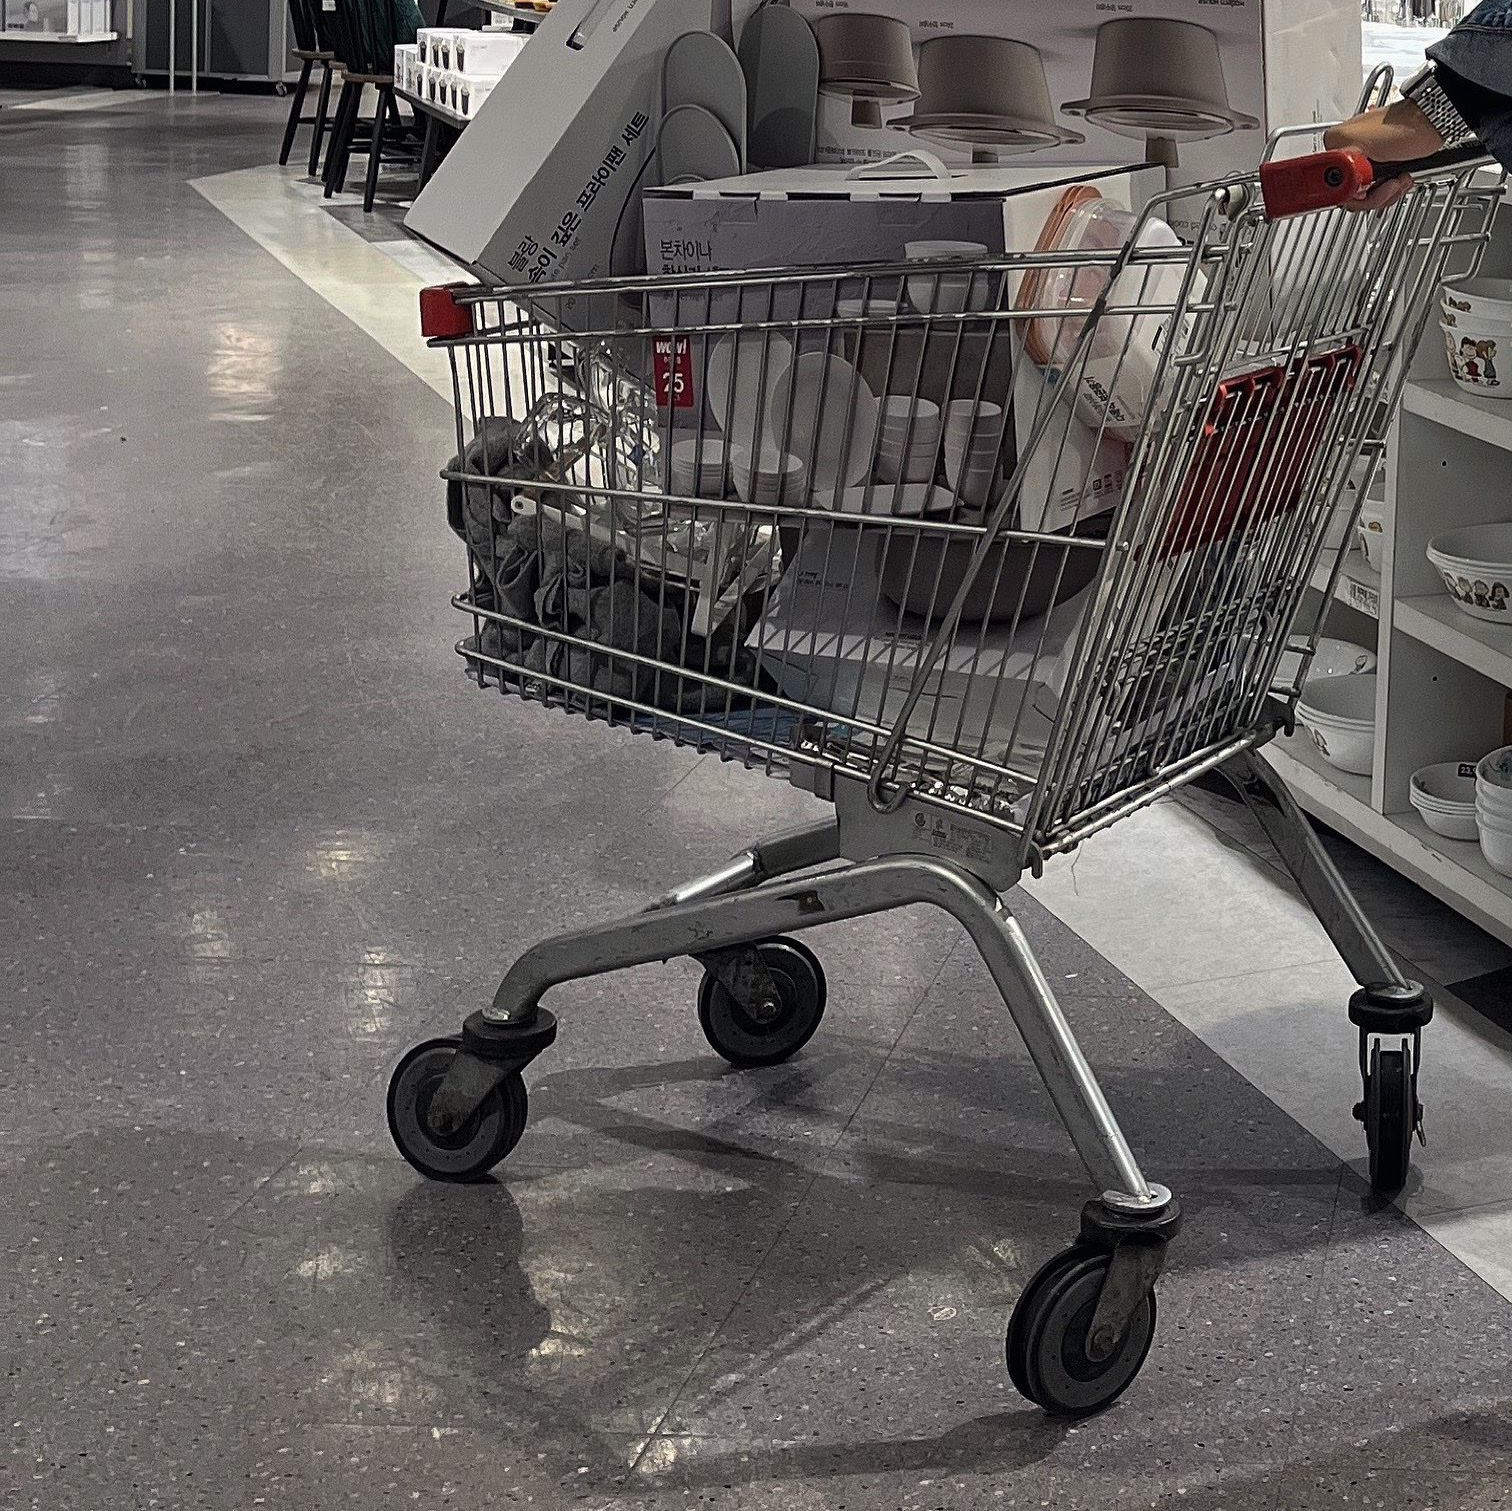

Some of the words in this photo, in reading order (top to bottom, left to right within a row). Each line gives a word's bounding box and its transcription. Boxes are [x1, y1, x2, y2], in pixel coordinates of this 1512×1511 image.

[528, 246, 558, 284] 속이
[550, 211, 583, 248] 깊은
[575, 144, 627, 213] 프라이팬
[620, 111, 650, 147] 세트
[507, 235, 539, 273] 블랑
[660, 239, 713, 263] 본차이나
